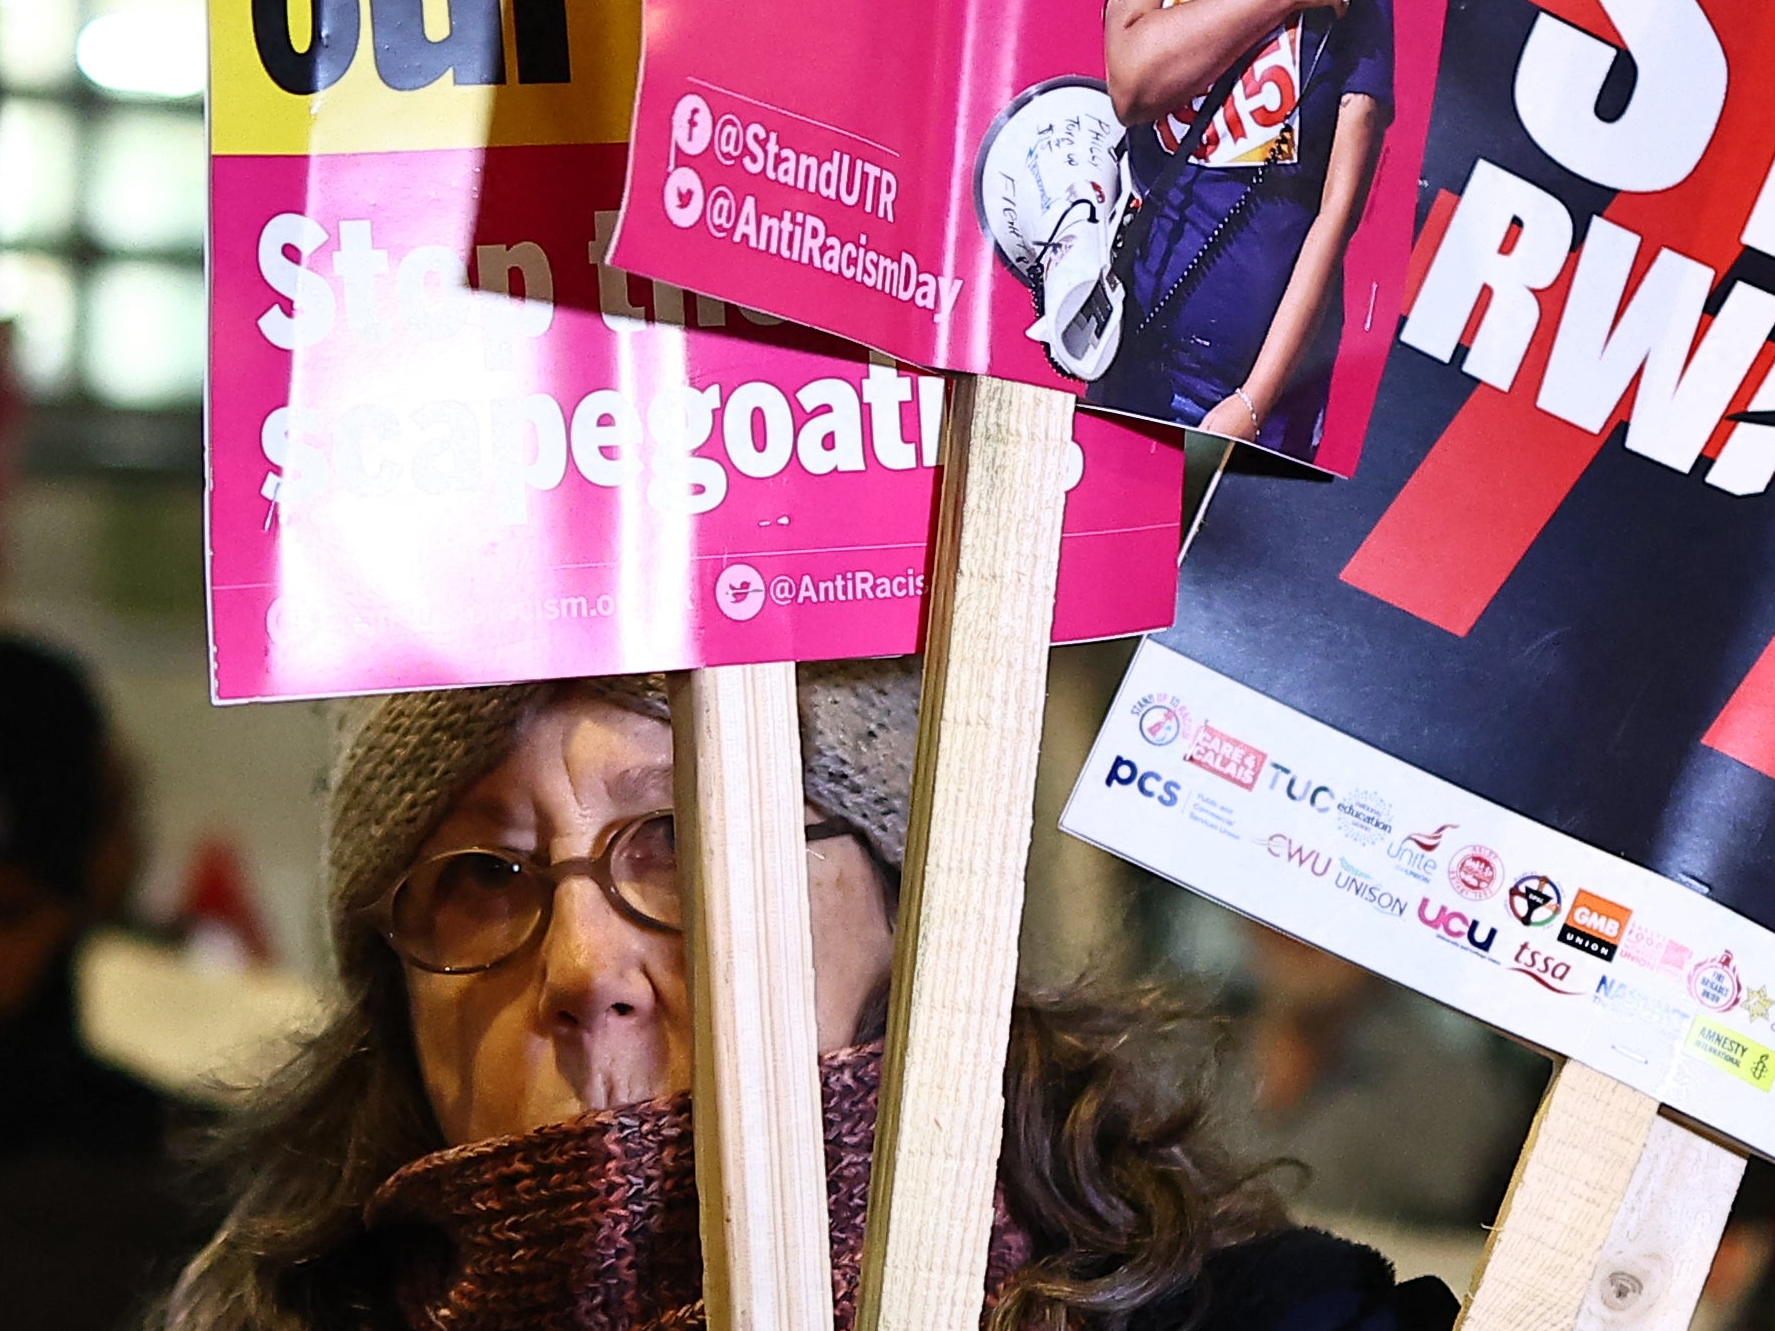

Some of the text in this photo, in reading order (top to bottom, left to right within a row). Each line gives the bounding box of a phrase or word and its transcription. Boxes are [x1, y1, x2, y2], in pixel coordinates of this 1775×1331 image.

[712, 111, 899, 224] @StandUTR
[705, 190, 963, 328] @AntiRacismDay
[256, 212, 556, 370] Stop
[769, 568, 927, 606] @AntiRacis
[1192, 745, 1256, 785] CALAIS
[1197, 729, 1240, 760] CARE
[1104, 754, 1182, 808] pcs
[1268, 761, 1336, 814] TUC
[1336, 801, 1393, 835] education
[1266, 832, 1333, 878] CWU
[1386, 839, 1438, 876] unite
[1334, 871, 1409, 917] UNISON
[1573, 905, 1622, 939] GMB
[1513, 940, 1574, 982] tssa
[1565, 931, 1610, 957] UNION
[1697, 1025, 1749, 1059] AMNESTY
